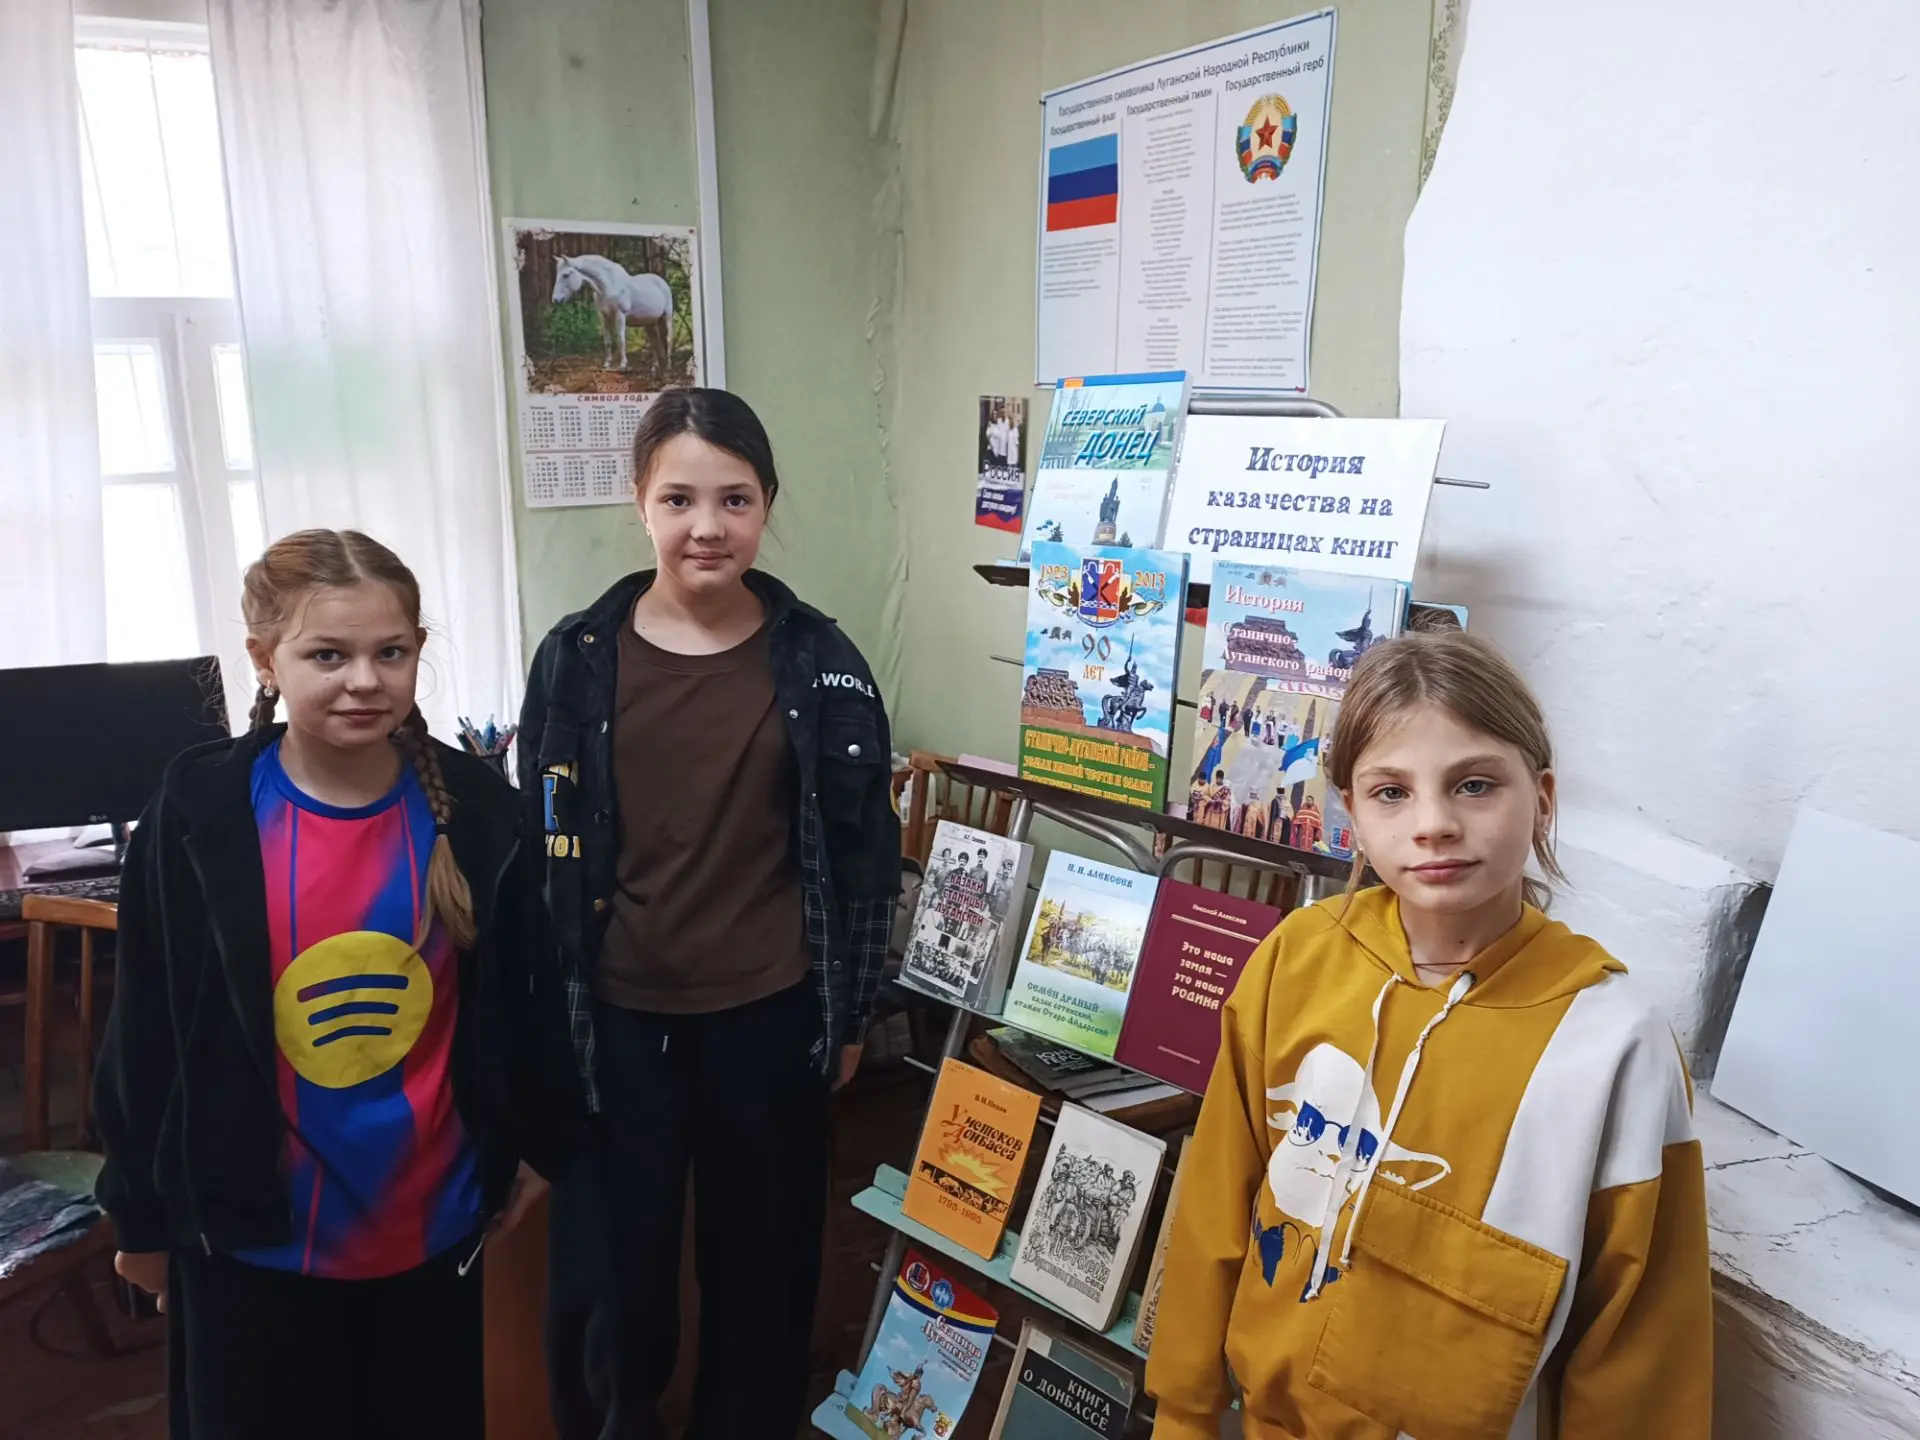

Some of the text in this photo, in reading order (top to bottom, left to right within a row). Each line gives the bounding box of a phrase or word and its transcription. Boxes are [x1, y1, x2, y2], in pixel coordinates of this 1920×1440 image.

[1156, 66, 1201, 91] Луганской
[1203, 54, 1249, 78] Народной
[1252, 40, 1310, 65] Республики
[1225, 55, 1325, 92] Государственный герб
[1126, 90, 1190, 116] Государственный
[1191, 87, 1213, 100] гимн
[1062, 404, 1148, 427] СЕВЕРСКИЙ
[1074, 429, 1160, 467] ДОНЕЦ
[1246, 446, 1366, 479] История
[1207, 490, 1394, 517] казачества на
[1188, 526, 1400, 560] страницах книг
[1225, 583, 1305, 614] История
[1081, 633, 1112, 662] 90
[1222, 620, 1299, 646] Станично-
[1220, 645, 1301, 671] Луганского
[1180, 958, 1213, 975] земля
[1182, 941, 1234, 966] Это наша
[1175, 972, 1225, 996] это наша
[943, 1126, 1017, 1162] Донбасса
[964, 1116, 1024, 1152] истоков
[1023, 1369, 1104, 1431] О ДОНБАССЕ
[1067, 1379, 1110, 1416] КНИГА
